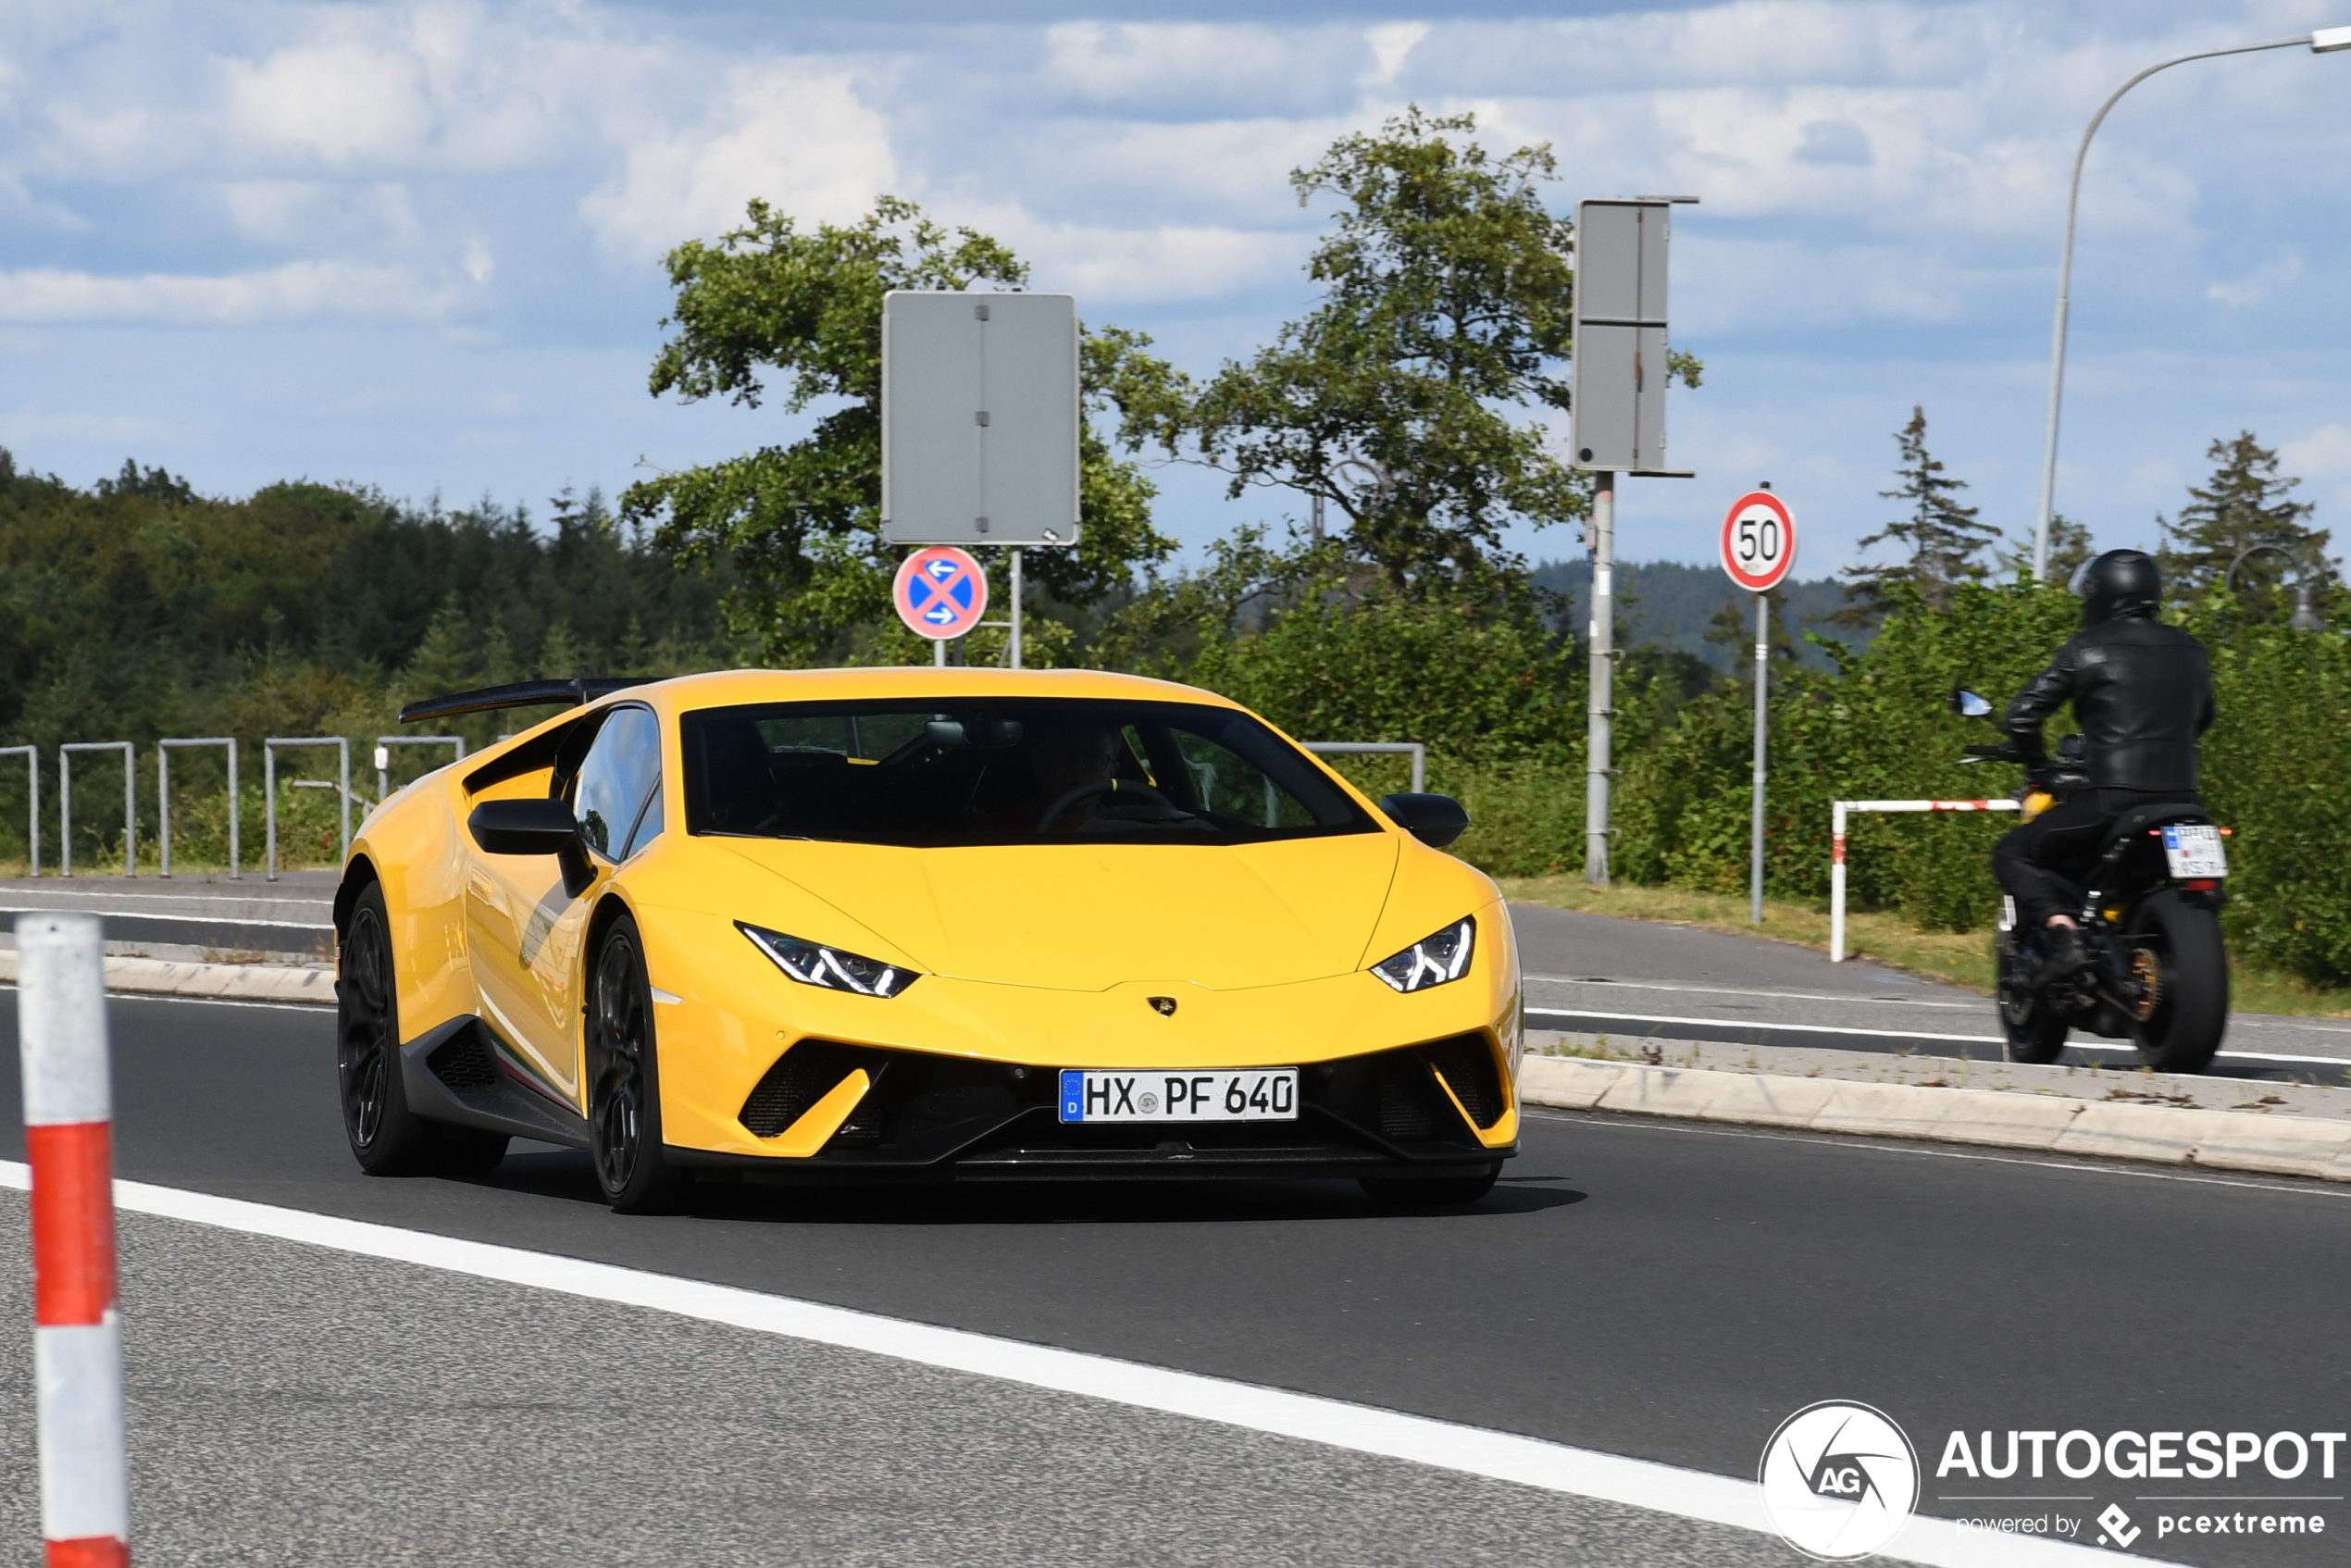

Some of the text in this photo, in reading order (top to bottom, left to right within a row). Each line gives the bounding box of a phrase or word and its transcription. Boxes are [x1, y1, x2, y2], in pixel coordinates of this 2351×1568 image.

[1739, 519, 1778, 562] 50
[1066, 1101, 1078, 1114] D
[1085, 1075, 1294, 1116] HX PF 640
